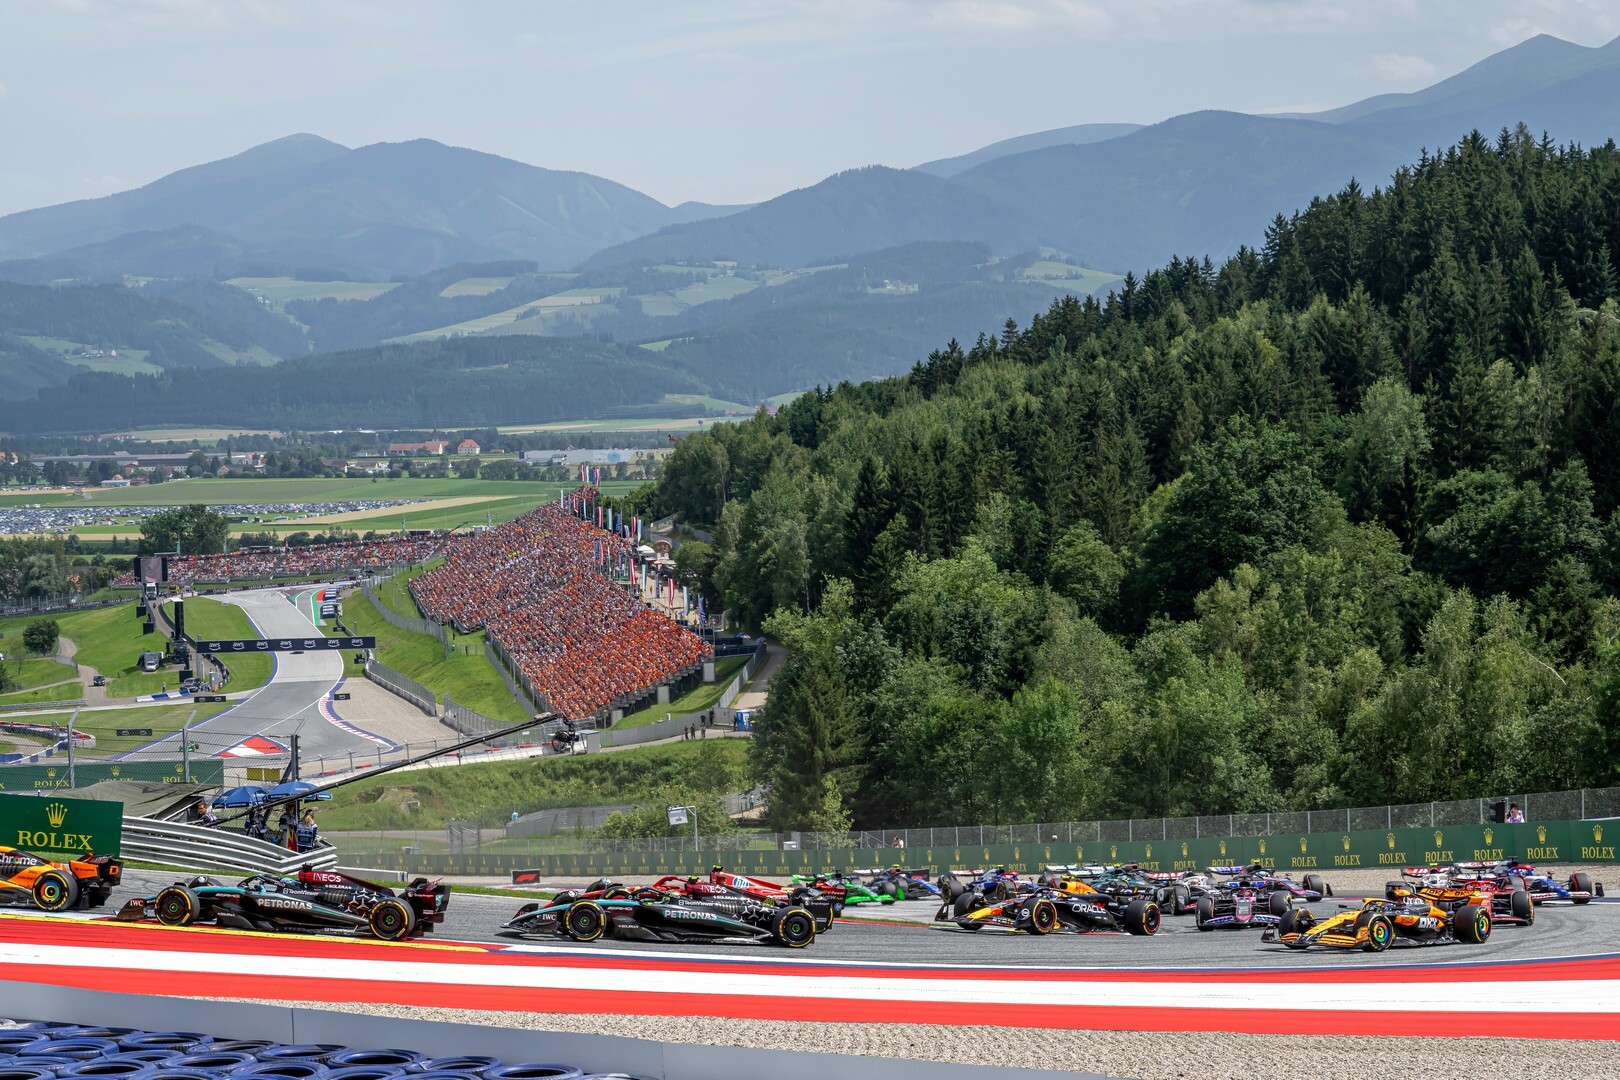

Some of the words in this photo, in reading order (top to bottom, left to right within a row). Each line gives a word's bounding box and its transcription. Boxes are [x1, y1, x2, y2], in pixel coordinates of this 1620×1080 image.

[34, 780, 70, 788] ROLEX
[17, 830, 93, 850] ROLEX
[1379, 853, 1406, 864] ROLEX
[1425, 851, 1454, 862] ROLEX
[1474, 849, 1503, 860] ROLEX
[1527, 847, 1559, 859] ROLEX
[1581, 847, 1615, 859] ROLEX
[1174, 860, 1196, 870] ROLEX
[1292, 856, 1317, 867] ROLEX
[1335, 854, 1360, 865] ROLEX
[1008, 863, 1026, 872] ROLEX
[313, 873, 341, 882] INEOS
[700, 884, 727, 894] INEOS
[258, 899, 313, 910] PETRONAS
[1072, 904, 1106, 913] ORACLE
[664, 910, 717, 920] PETRONAS
